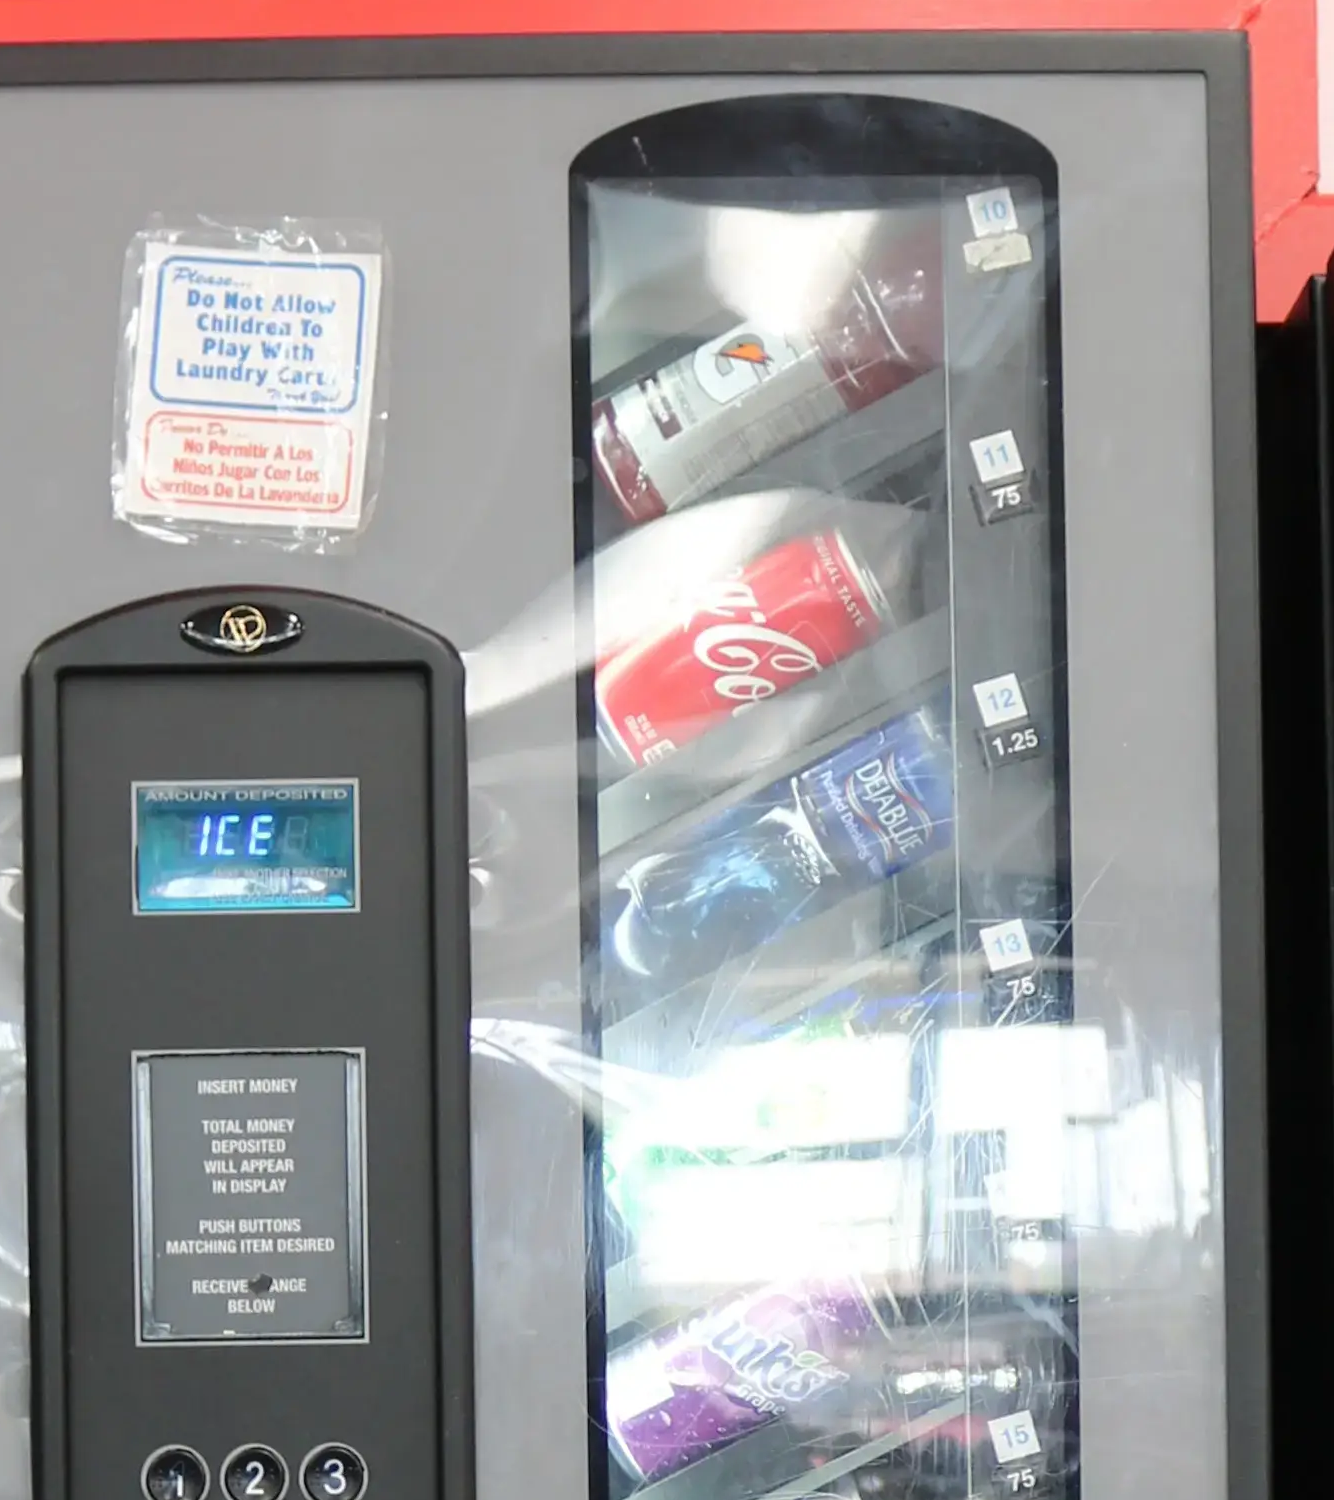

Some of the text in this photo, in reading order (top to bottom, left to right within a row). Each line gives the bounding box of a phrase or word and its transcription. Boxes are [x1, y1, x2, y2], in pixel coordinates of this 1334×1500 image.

[979, 199, 1008, 223] 10
[186, 288, 336, 314] Do Not Allow
[196, 312, 323, 338] Children To
[202, 337, 315, 362] Play With
[176, 358, 268, 387] Laundry
[183, 437, 314, 462] No Permitir A Los
[983, 443, 1010, 467] 11
[218, 461, 259, 483] Jugar
[264, 464, 291, 481] Con
[296, 466, 321, 483] Los
[214, 482, 234, 499] De
[238, 484, 255, 500] La
[992, 485, 1021, 510] 75
[836, 585, 868, 629] TASTE
[986, 686, 1017, 711] 12
[992, 728, 1039, 757] 1.25
[144, 787, 349, 802] AMOUNT DEPOSITED
[199, 814, 273, 857] ICE
[992, 932, 1023, 957] 13
[1006, 975, 1036, 1000] 75
[197, 1078, 299, 1094] INSERT MONEY
[201, 1118, 296, 1134] TOTAL MONEY
[211, 1139, 287, 1154] DEPOSITED
[203, 1158, 295, 1174] WILL APPEAR
[212, 1178, 287, 1194] IN DISPLAY
[199, 1218, 302, 1234] PUSH BUTTONS
[1011, 1220, 1039, 1240] 75
[166, 1237, 335, 1255] MATCHING ITEM DESIRED
[192, 1278, 307, 1294] RECEIVE ANGE
[227, 1299, 276, 1314] BELOW
[734, 1387, 786, 1418] Grape
[1000, 1423, 1030, 1448] 15
[244, 1460, 265, 1495] 2
[322, 1458, 347, 1495] 3
[1005, 1468, 1037, 1492] 75
